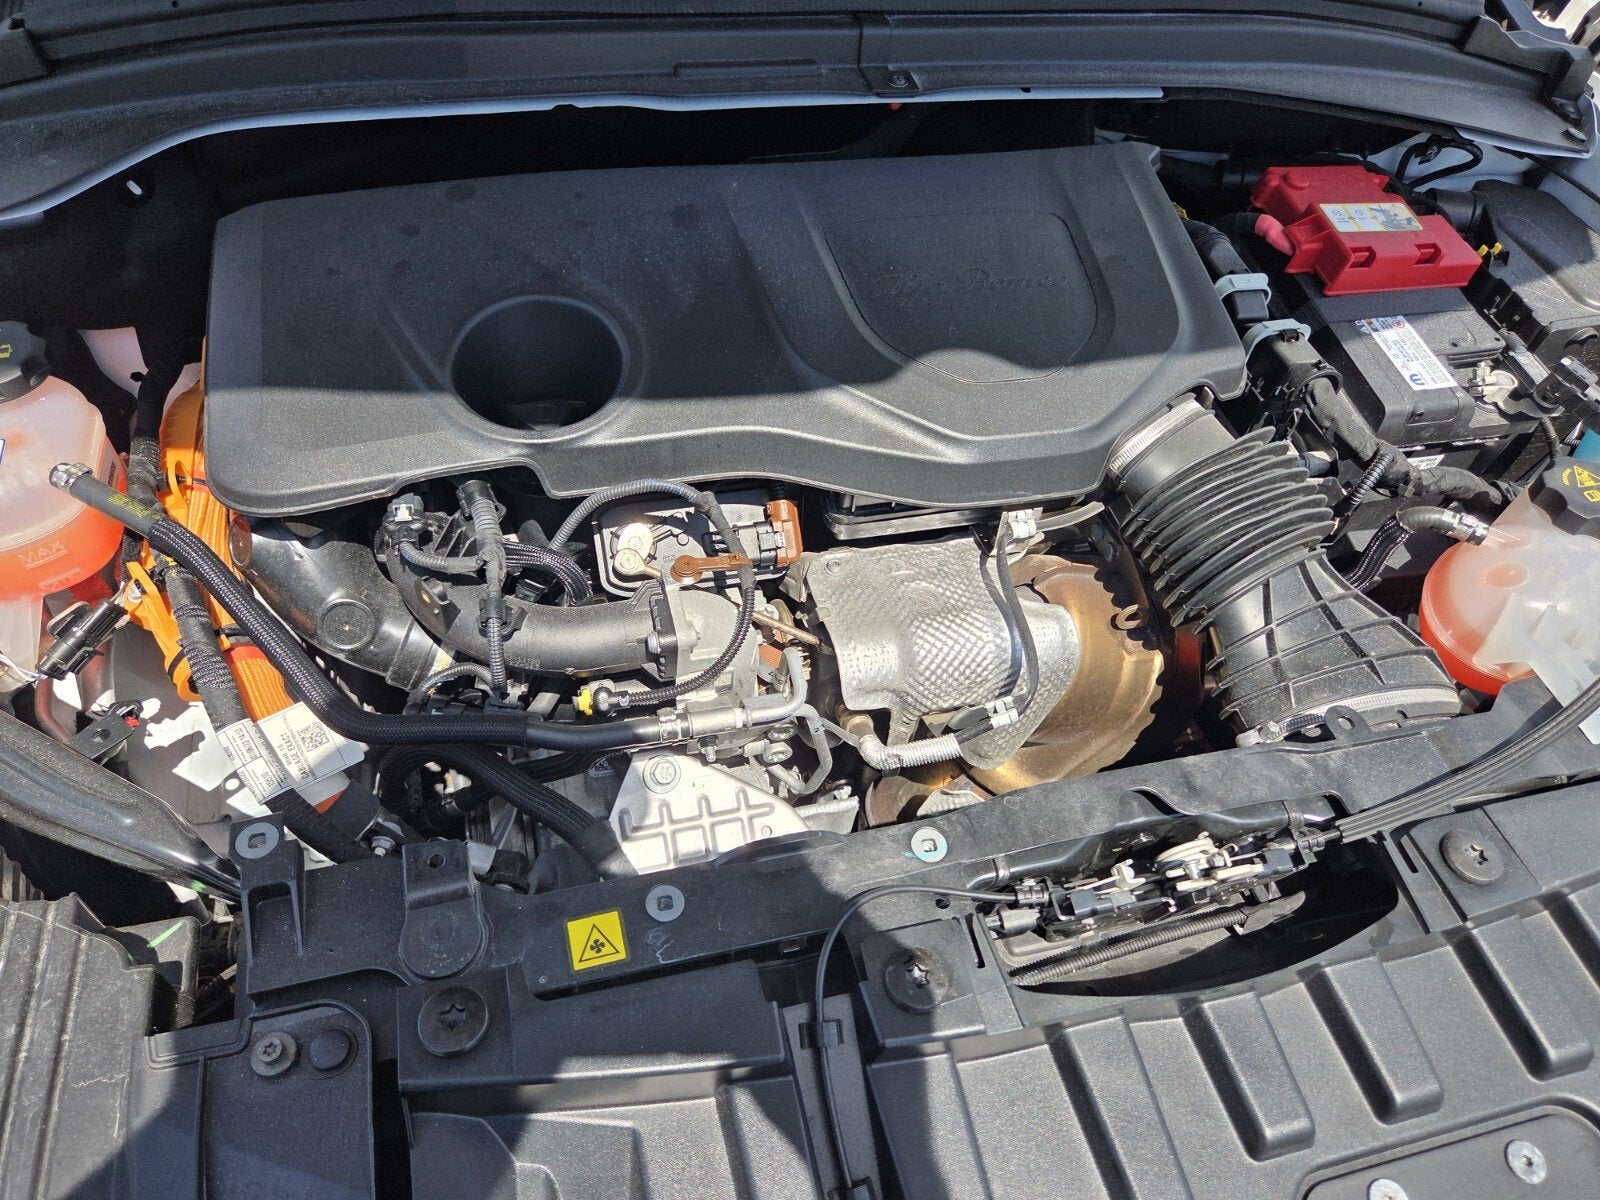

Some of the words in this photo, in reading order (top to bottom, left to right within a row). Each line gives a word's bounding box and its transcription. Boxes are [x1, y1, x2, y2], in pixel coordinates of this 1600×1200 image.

[18, 540, 65, 565] MAX
[280, 732, 296, 752] EXACT
[291, 752, 310, 779] CABLAGE
